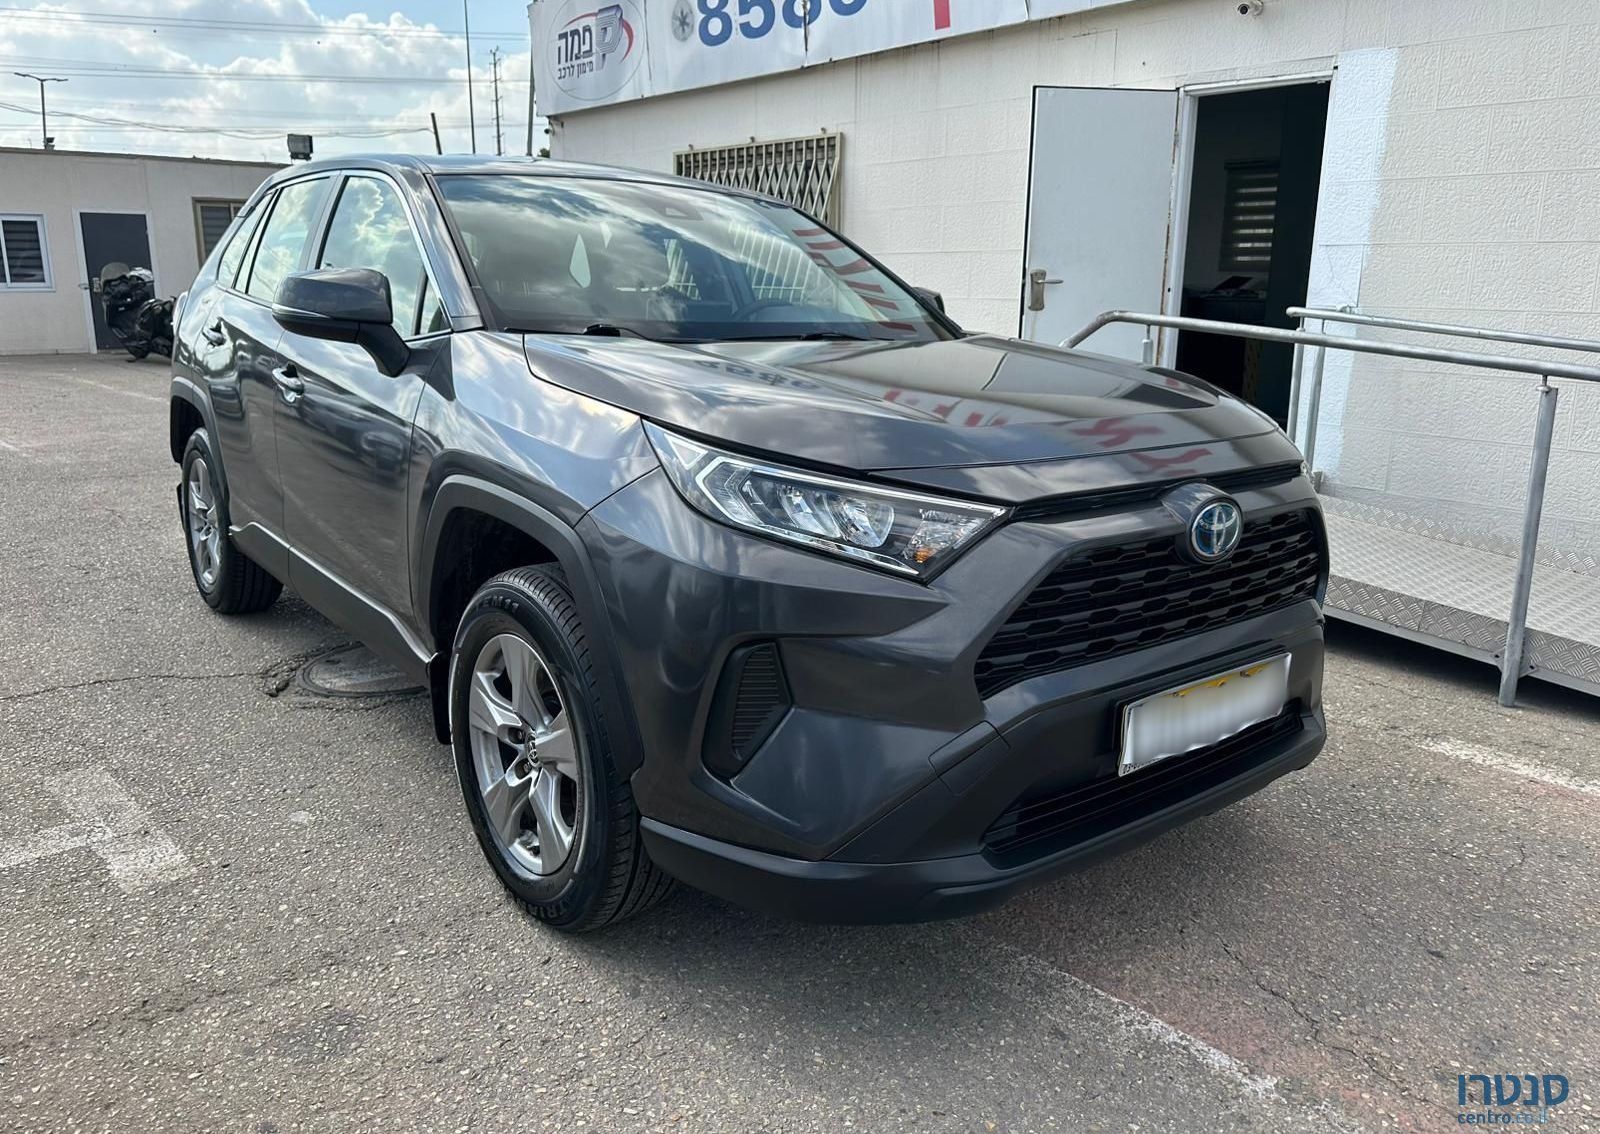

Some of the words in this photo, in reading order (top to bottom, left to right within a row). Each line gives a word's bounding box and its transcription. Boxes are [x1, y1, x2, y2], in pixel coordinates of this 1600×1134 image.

[700, 0, 867, 46] 85
[557, 24, 593, 65] פמה
[557, 64, 575, 80] לרכב
[576, 60, 594, 78] מימון
